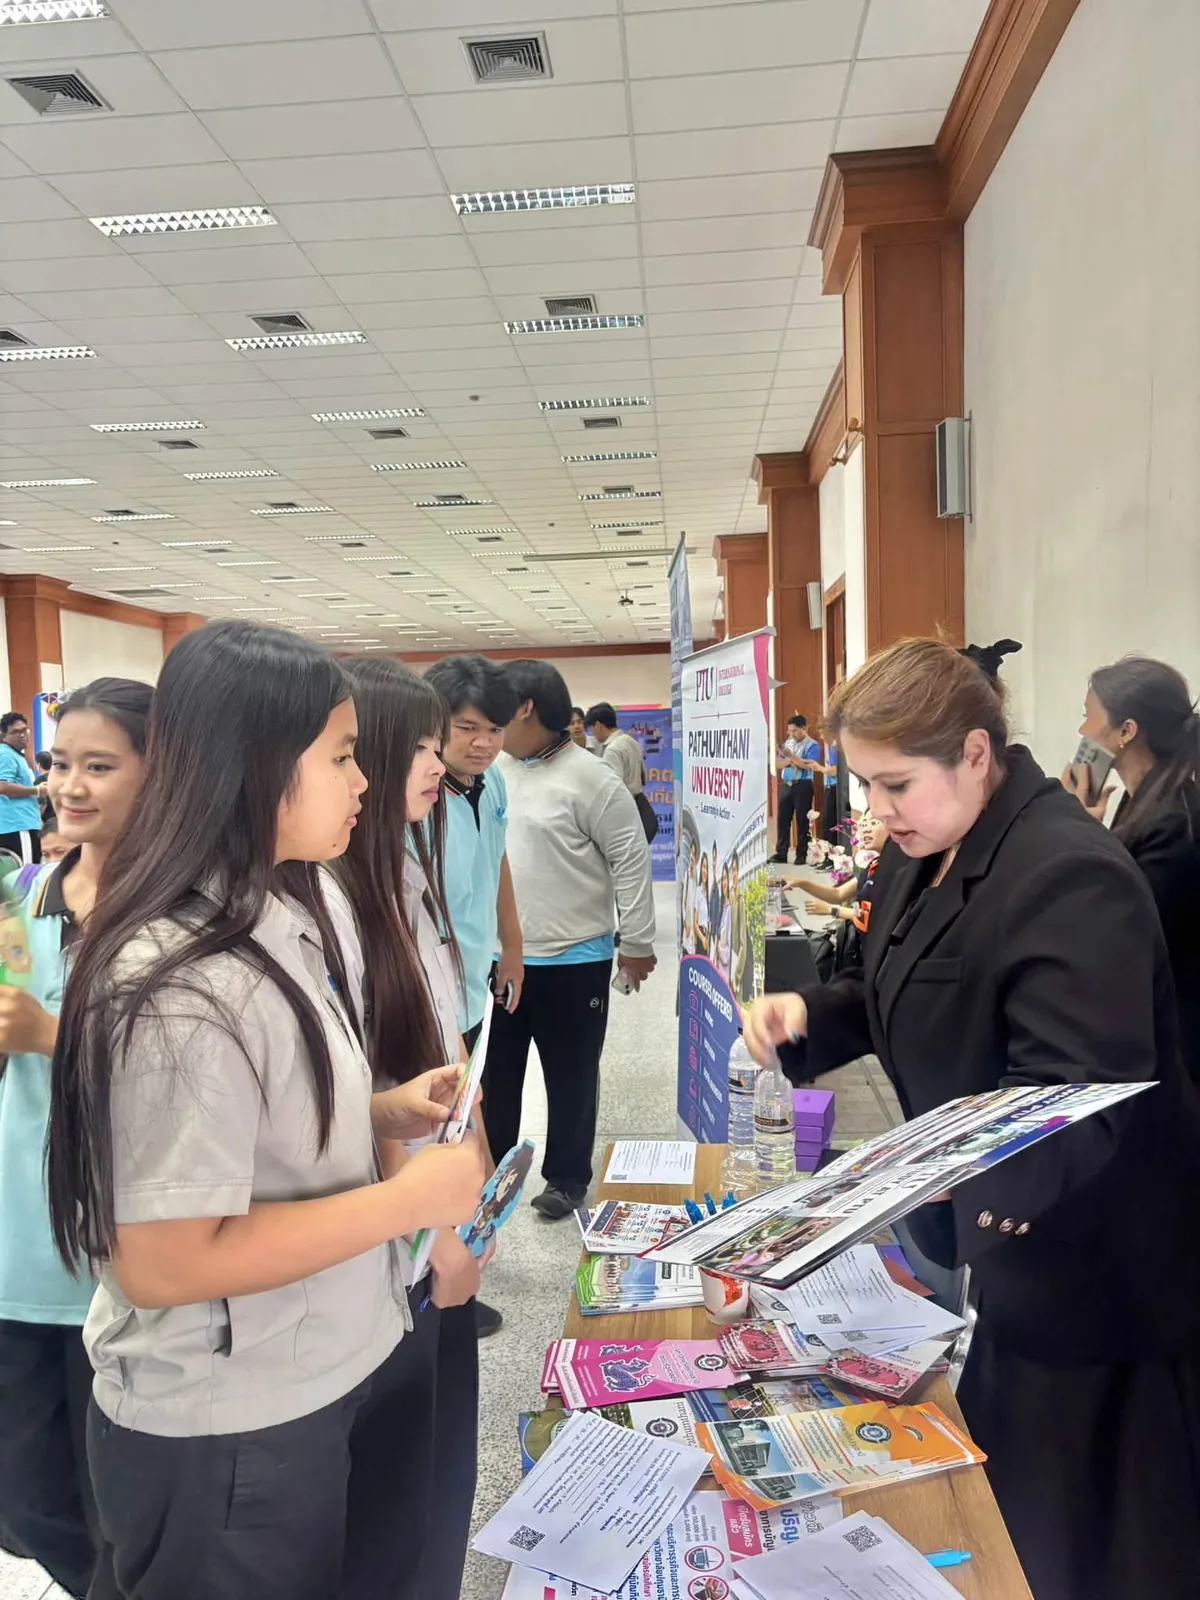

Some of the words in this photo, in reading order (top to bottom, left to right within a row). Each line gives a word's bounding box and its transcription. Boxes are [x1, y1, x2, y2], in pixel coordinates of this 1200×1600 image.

[695, 666, 714, 702] PTU
[688, 727, 750, 761] PATHUMTHANI
[691, 765, 744, 802] UNIVERSITY
[779, 1508, 801, 1545] ปริญ
